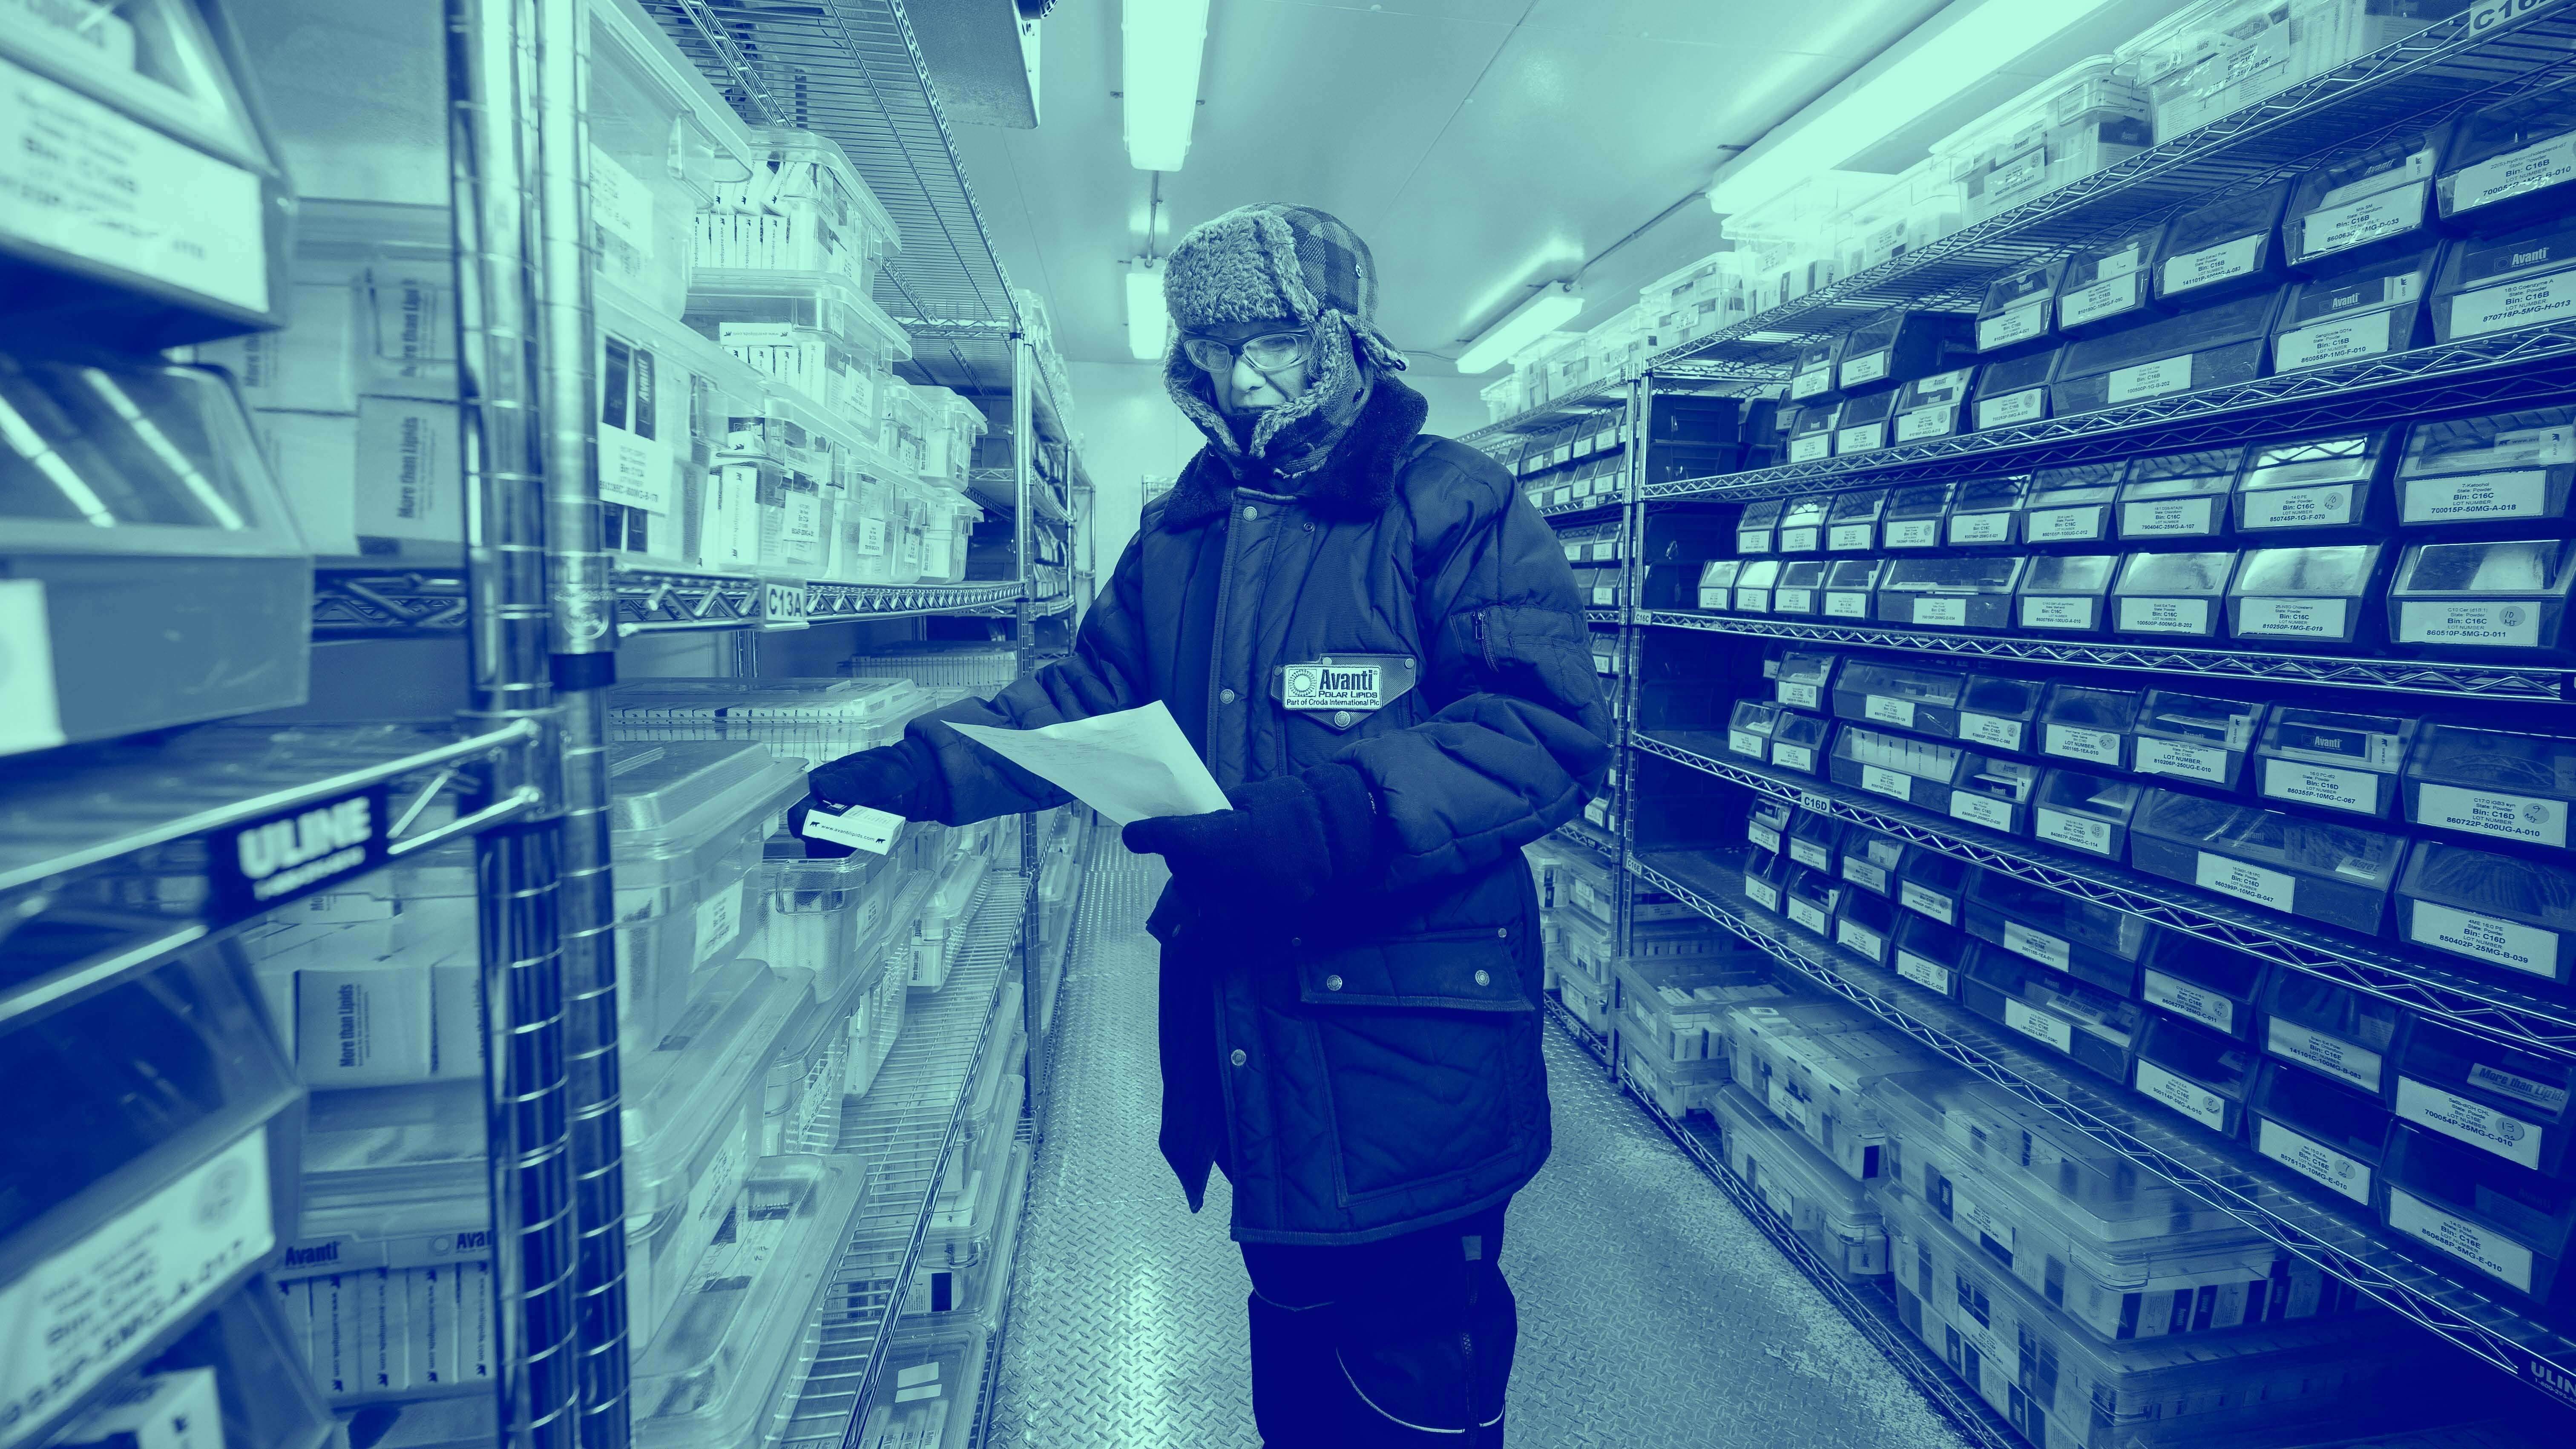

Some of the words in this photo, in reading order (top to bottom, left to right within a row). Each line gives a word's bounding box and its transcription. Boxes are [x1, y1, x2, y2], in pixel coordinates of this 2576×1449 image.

[2526, 159, 2550, 171] C16B
[2352, 215, 2369, 224] C16B
[2513, 247, 2547, 265] Avanti
[2518, 281, 2547, 290] Coenzyme
[2333, 293, 2358, 308] Avanti
[2526, 291, 2549, 300] C16B
[2483, 300, 2570, 322] 870718P-5MG-H-013
[2301, 346, 2366, 362] 860055P-1MG-F-010
[2431, 504, 2516, 514] 700015P-50MG-A-018
[770, 588, 802, 618] C13A
[1636, 614, 1649, 622] C16C
[1319, 670, 1373, 690] Avanti
[2314, 736, 2340, 748] Avanti
[2154, 759, 2211, 772] 810206P-250UG-E-010
[2176, 756, 2202, 765] NUMBER:
[1804, 797, 1827, 811] C16D
[2287, 788, 2356, 804] 860355P-10MG-C-067
[2492, 811, 2515, 819] C16D
[821, 825, 875, 842] www.avantilipids.com
[2447, 817, 2540, 837] 860722P-500UG-A-010
[237, 796, 372, 880] ULINE
[2215, 881, 2274, 902] 860399P-10MG-B-047
[2464, 929, 2481, 937] Bin:
[2483, 934, 2506, 944] C16D
[2484, 928, 2504, 936] Powder
[2439, 935, 2528, 963] 850402P-25MG-B-039
[337, 984, 354, 1015] Lipids
[2189, 999, 2202, 1007] C16E
[339, 1016, 355, 1039] than
[339, 1041, 355, 1067] More
[2310, 1044, 2323, 1053] Bin:
[2325, 1050, 2342, 1060] C16E
[2290, 1047, 2361, 1079] 141101C-100MG-B-083
[2479, 1067, 2509, 1084] More
[2511, 1076, 2533, 1092] than
[2166, 1084, 2176, 1092] Bin:
[2177, 1090, 2190, 1100] C16E
[2447, 1112, 2459, 1121] LOT
[2466, 1115, 2481, 1123] C16E
[2477, 1108, 2490, 1116] CHL
[2425, 1109, 2513, 1147] 700054P-25MG-C-010
[2502, 1121, 2514, 1133] 13
[2299, 1152, 2311, 1162] Bin:
[2313, 1159, 2329, 1170] C16E
[2281, 1154, 2347, 1190] 857511P-10MG-E-010
[2441, 1226, 2457, 1237] Bin:
[2459, 1235, 2481, 1249] C16E
[285, 1242, 338, 1266] Avanti
[2422, 1228, 2502, 1272] 860688P-5MG-E-010
